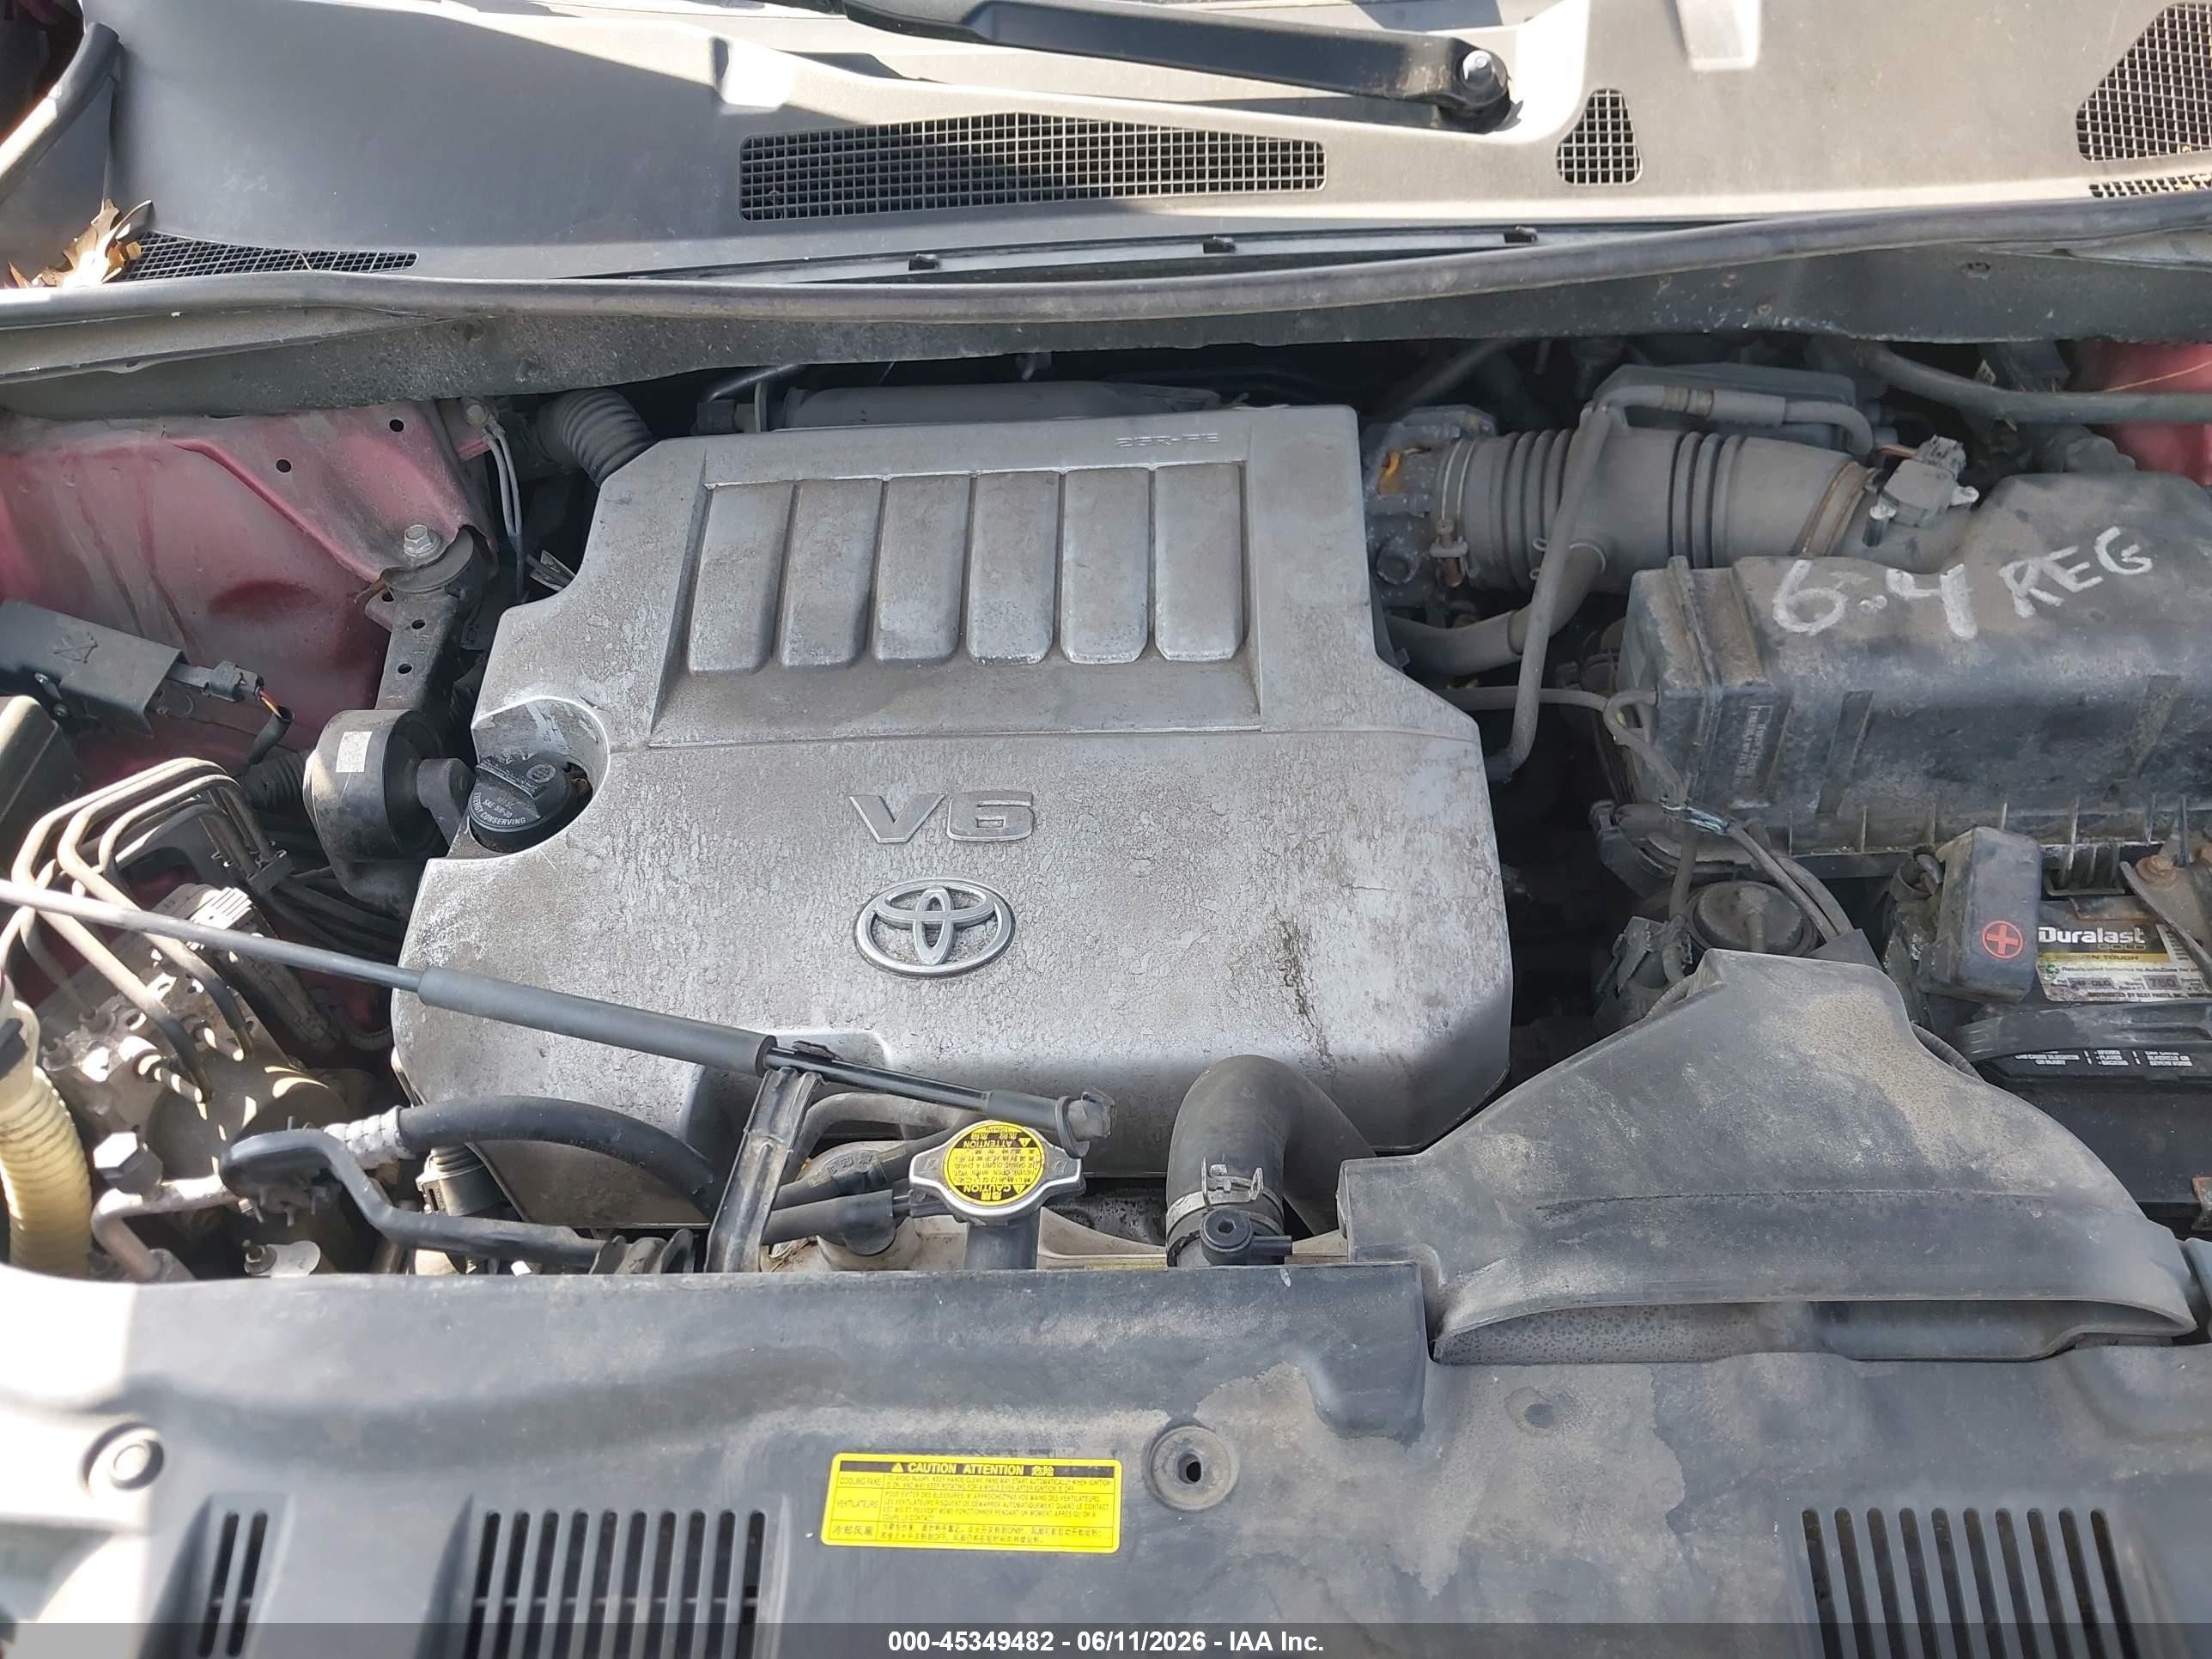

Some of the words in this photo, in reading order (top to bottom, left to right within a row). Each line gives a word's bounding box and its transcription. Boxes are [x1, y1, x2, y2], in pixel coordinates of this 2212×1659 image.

[1998, 526, 2153, 618] REG
[483, 799, 495, 808] SAE
[480, 811, 526, 825] CONSERVING
[848, 790, 1034, 844] V6
[2038, 927, 2146, 944] Duralast
[2148, 978, 2177, 988] 750
[907, 1463, 956, 1473] CAUTION
[963, 1464, 1024, 1474] ATTENTION
[1031, 1467, 1054, 1475] 危险
